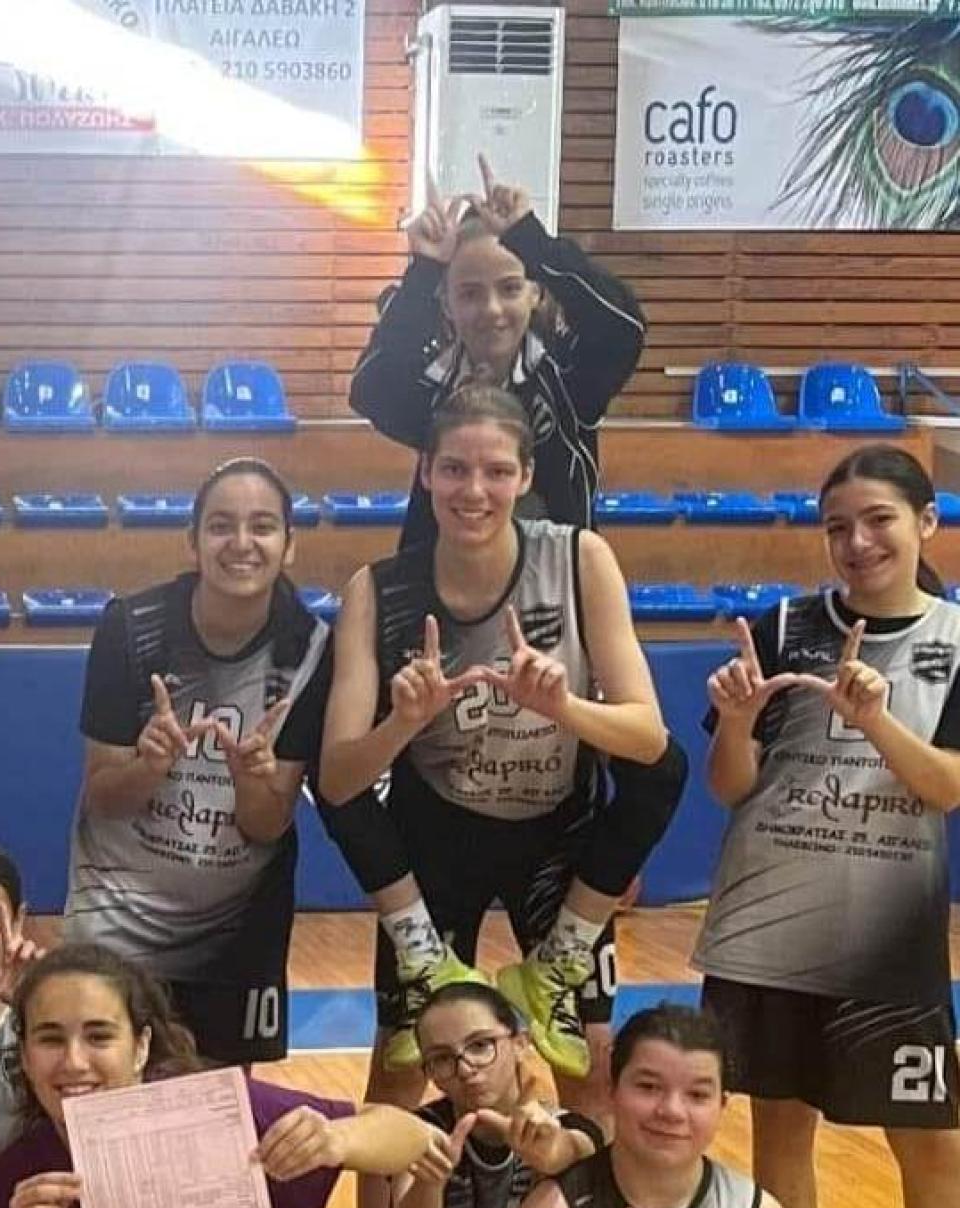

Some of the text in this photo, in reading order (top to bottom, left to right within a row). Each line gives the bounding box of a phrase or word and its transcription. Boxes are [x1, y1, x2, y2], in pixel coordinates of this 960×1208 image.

[250, 0, 338, 16] ΔΑΒΑΚΗ
[344, 0, 357, 17] 2
[209, 28, 301, 49] ΑΙΓΑΛΕΩ
[264, 62, 352, 81] 5903860
[645, 85, 737, 145] cafo
[644, 147, 735, 166] roasters
[243, 986, 279, 1040] 10
[891, 1044, 948, 1102] 21
